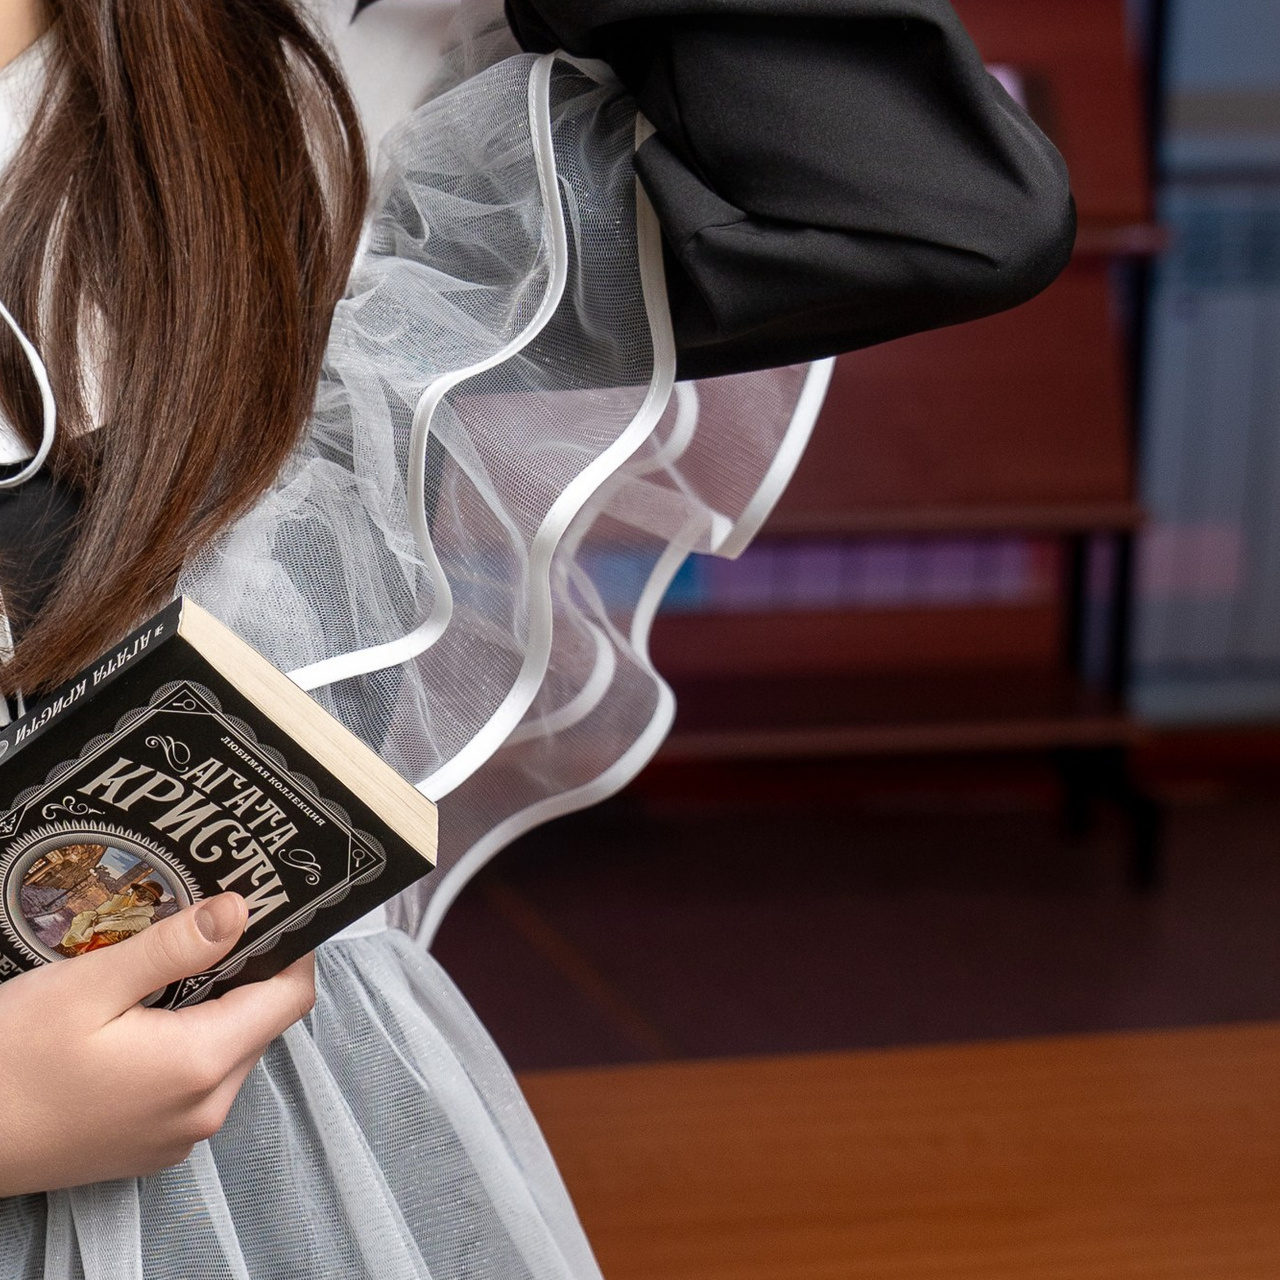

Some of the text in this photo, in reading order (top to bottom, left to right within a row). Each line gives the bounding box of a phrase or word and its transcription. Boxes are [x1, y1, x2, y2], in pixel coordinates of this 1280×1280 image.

[14, 629, 152, 746] АГАТА КРИСТИ
[180, 757, 299, 855] АГАТА
[220, 736, 327, 827] ЛЮБИМАЯ КОЛЛЕКЦИЯ
[77, 757, 291, 933] КРИСТИ
